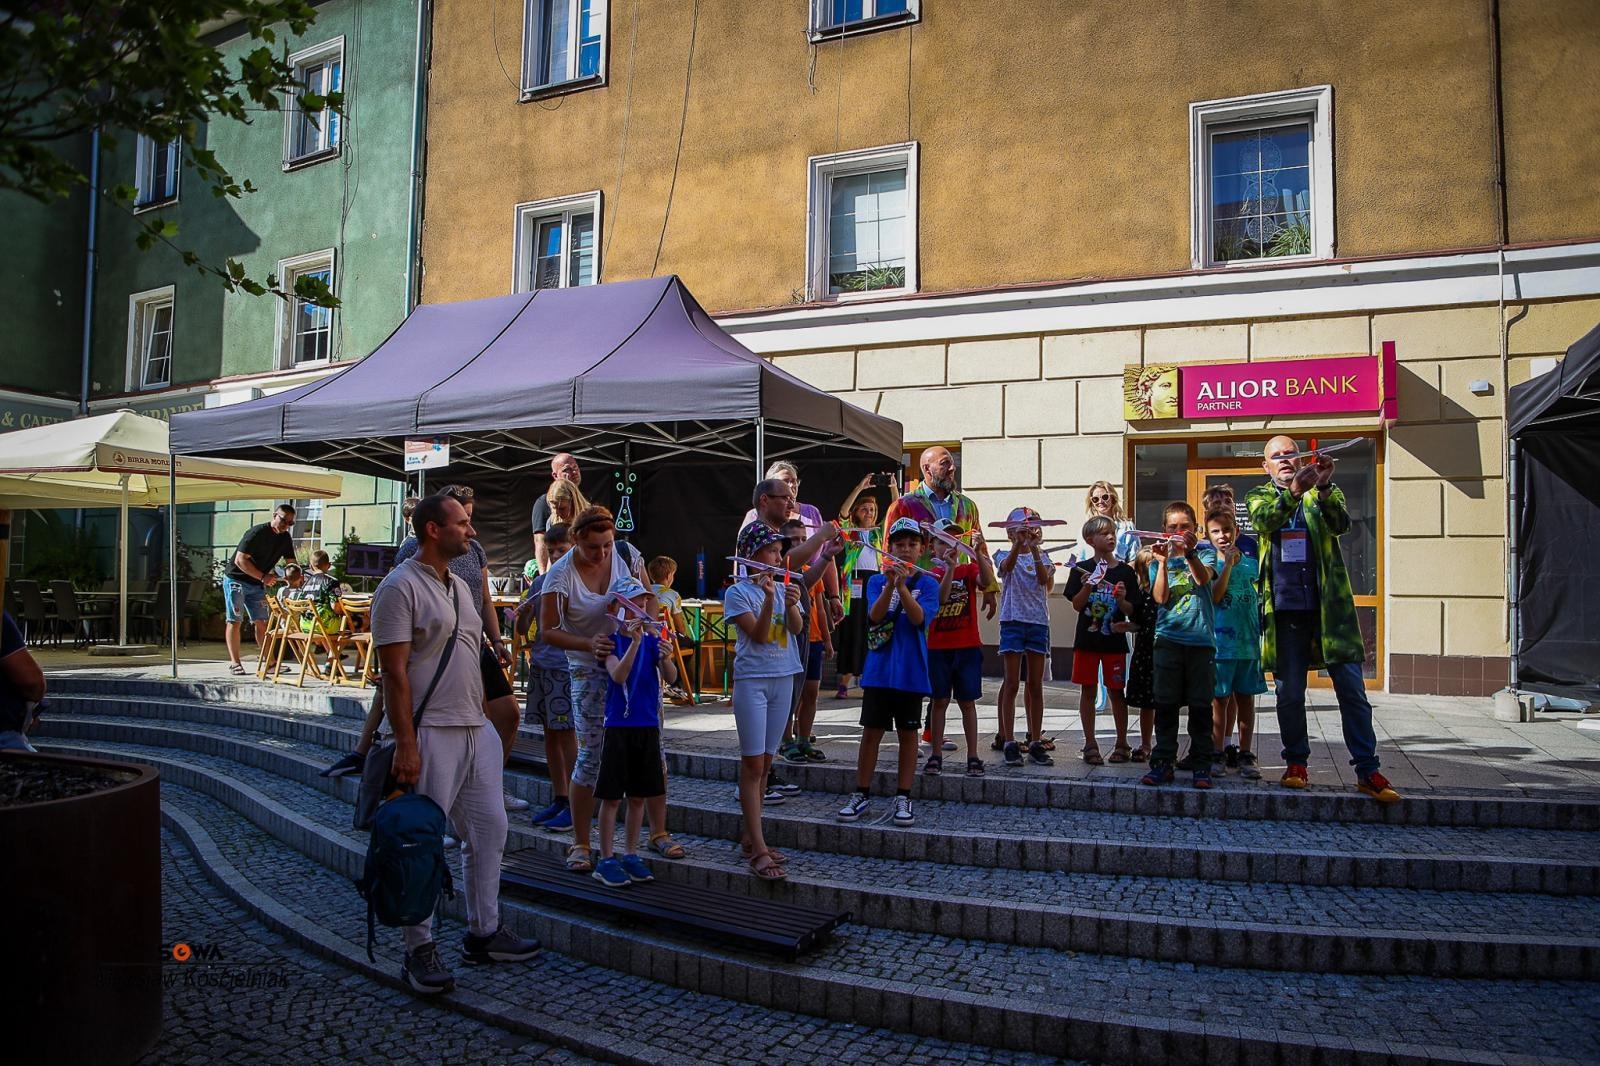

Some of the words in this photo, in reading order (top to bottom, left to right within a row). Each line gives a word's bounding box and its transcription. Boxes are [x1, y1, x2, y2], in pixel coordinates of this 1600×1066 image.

[1197, 379, 1279, 400] ALIOR
[1285, 375, 1358, 396] BANK
[1197, 401, 1242, 411] PARTNER
[1, 411, 15, 427] &
[127, 456, 150, 465] BIRRA
[935, 602, 964, 618] PEED
